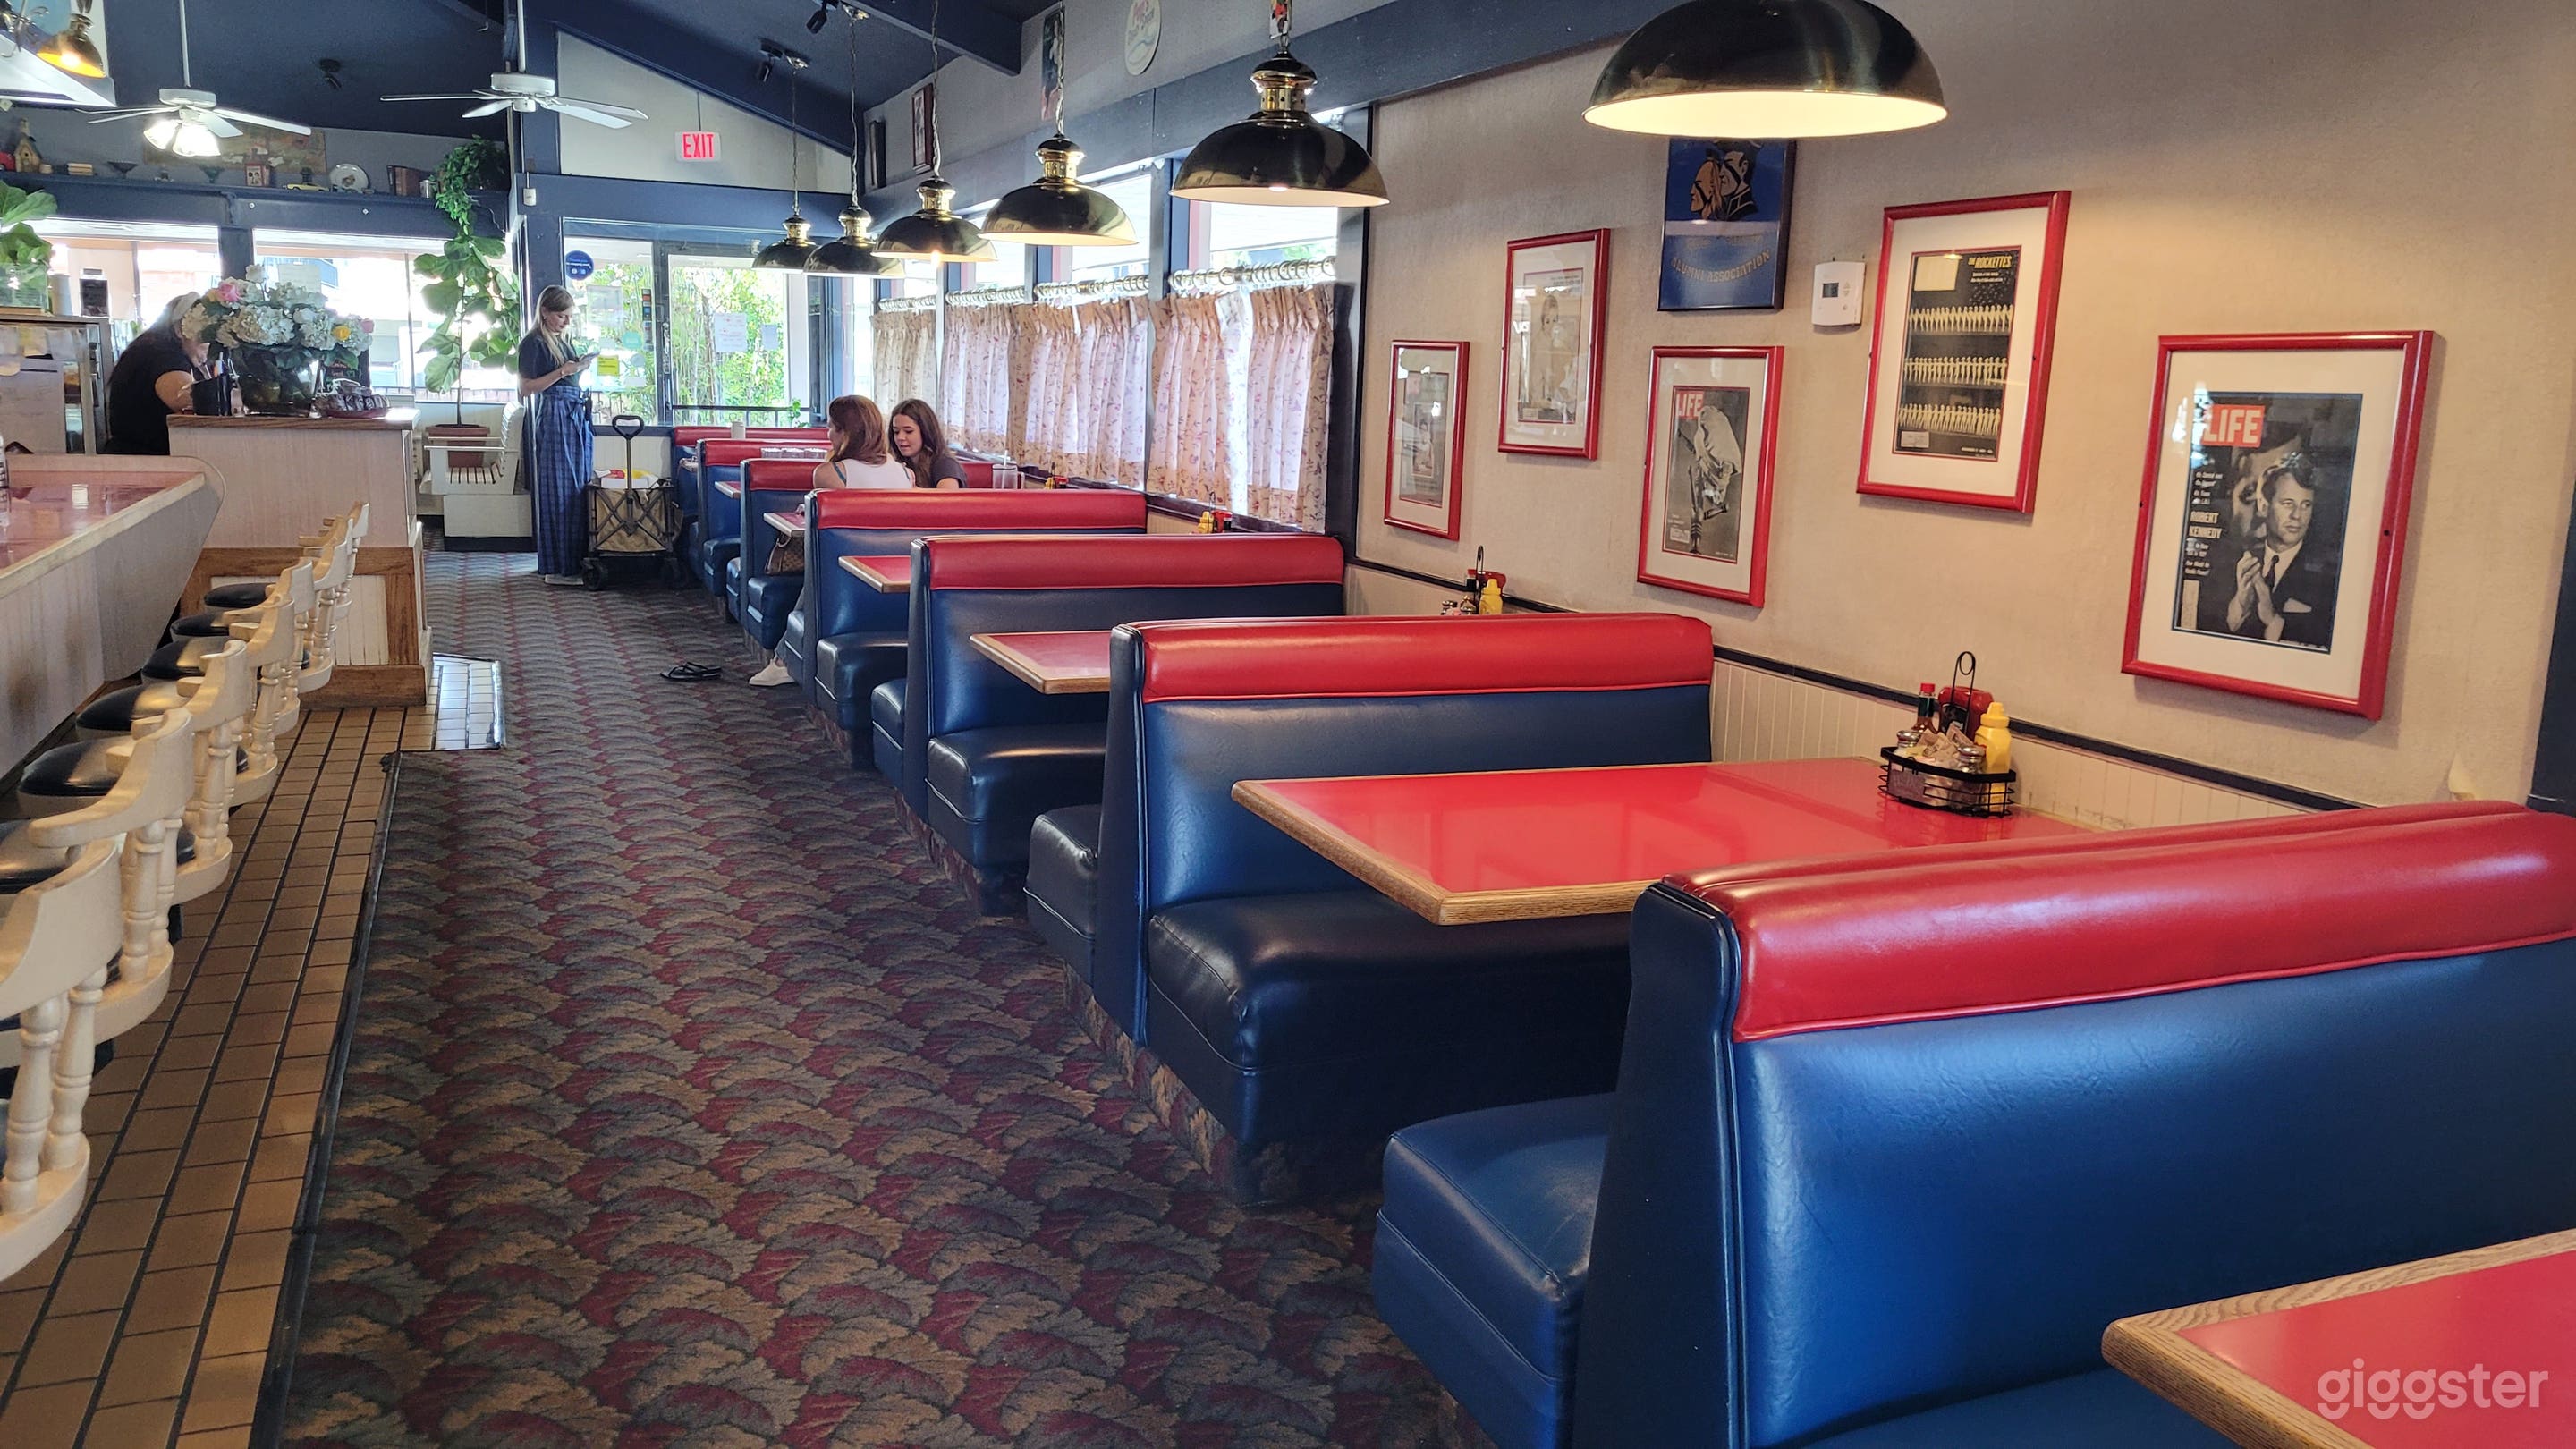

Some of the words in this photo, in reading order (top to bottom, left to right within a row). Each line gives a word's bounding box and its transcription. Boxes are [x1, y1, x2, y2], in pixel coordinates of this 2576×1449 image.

[682, 133, 714, 158] EXIT
[1670, 257, 1704, 281] ALUMNI
[1706, 250, 1771, 283] ASSOCIATION
[1974, 255, 2012, 268] ROCKETTES
[1675, 393, 1704, 418] LIFE
[2202, 409, 2262, 444] LIFE
[2190, 511, 2219, 524] ROBERT
[2189, 525, 2223, 539] KENNEDY
